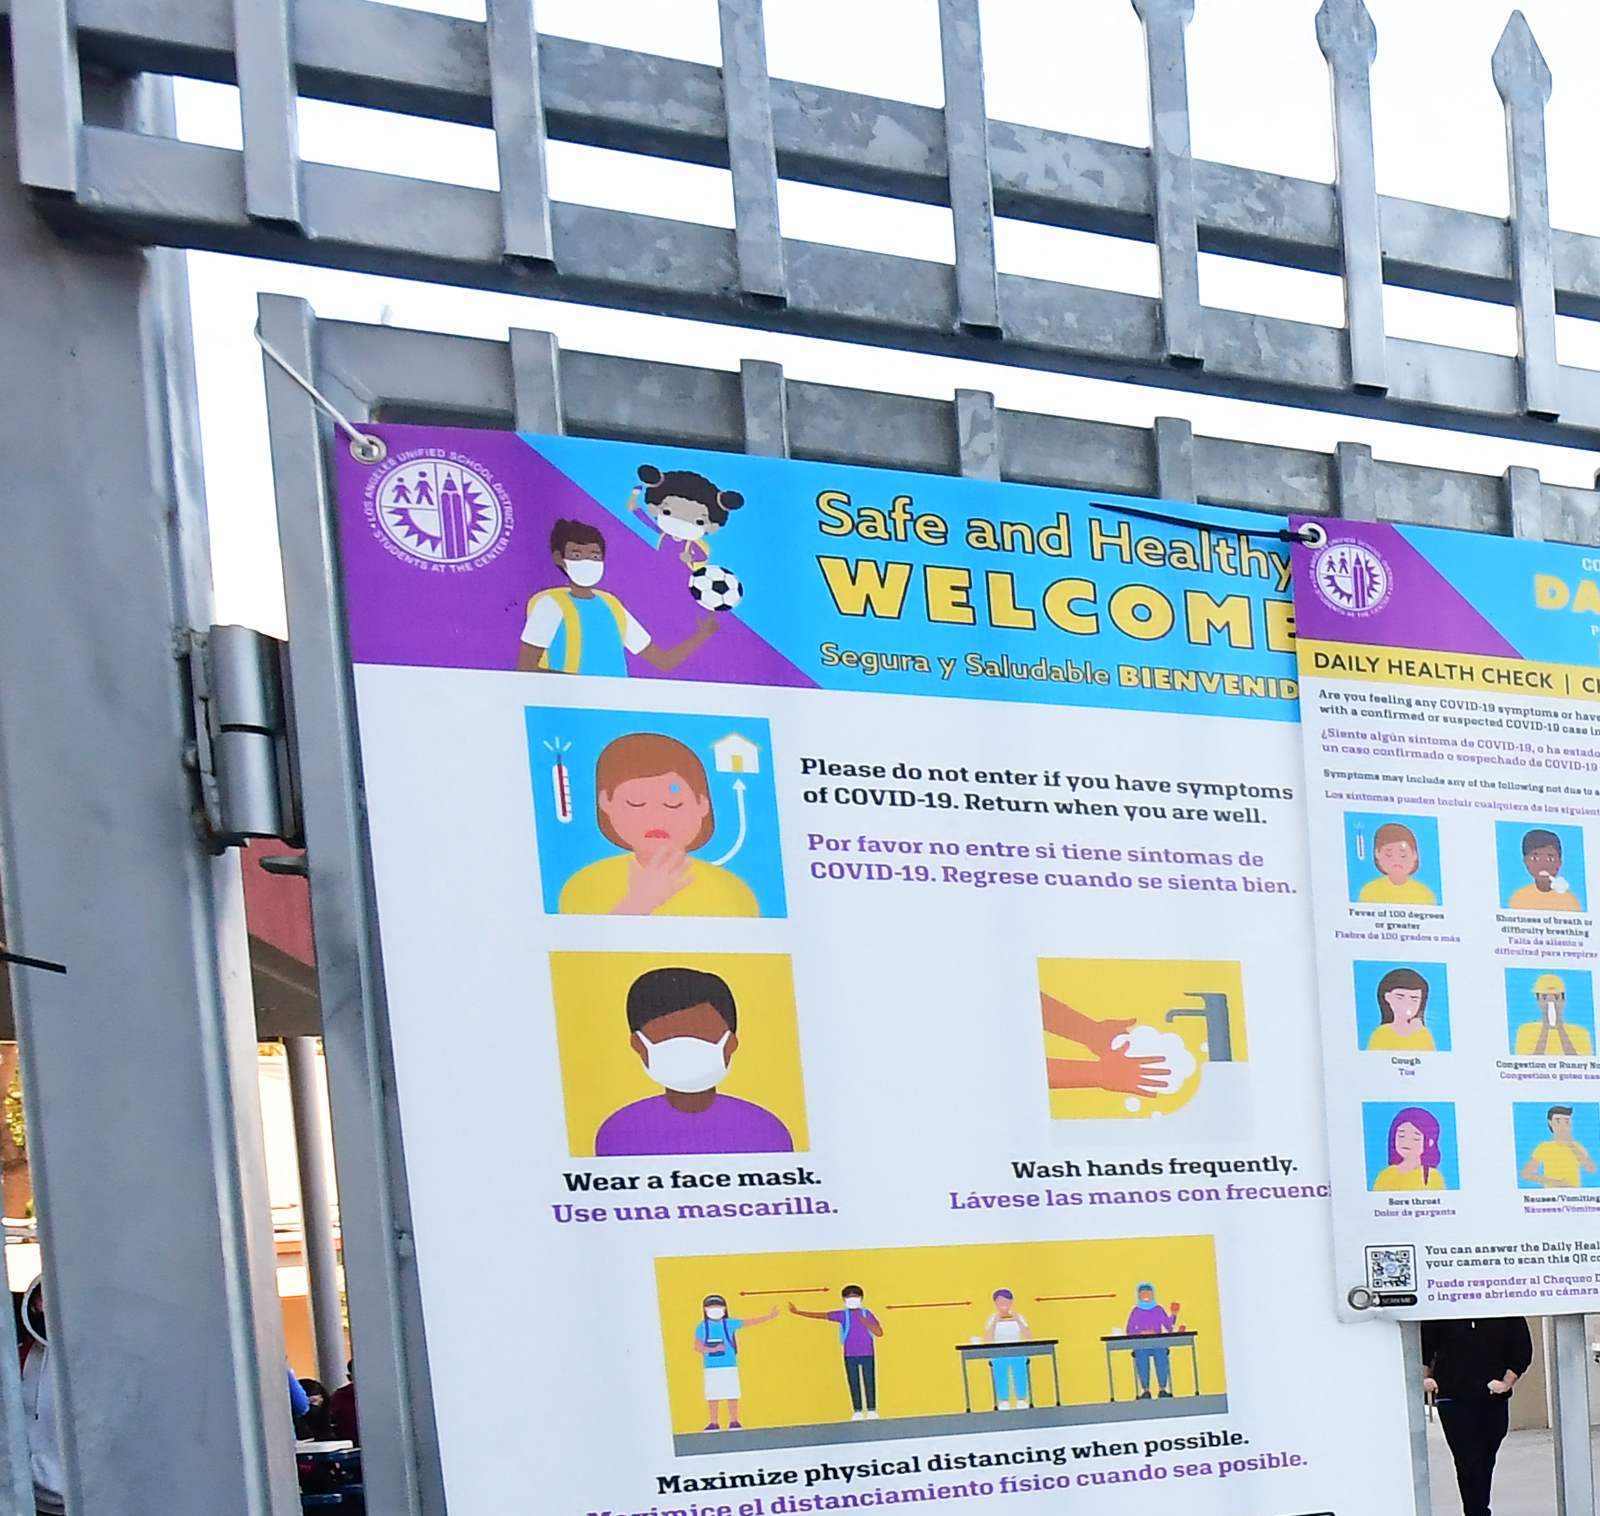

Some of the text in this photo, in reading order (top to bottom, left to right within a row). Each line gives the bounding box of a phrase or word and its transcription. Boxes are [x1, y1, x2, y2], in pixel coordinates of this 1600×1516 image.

[397, 448, 446, 462] UNIFIED
[450, 452, 494, 481] SCHOOL
[373, 530, 428, 571] STUDENTS
[431, 563, 445, 573] AT
[451, 563, 473, 573] THE
[817, 490, 949, 545] Safe
[966, 512, 1072, 559] and
[1089, 518, 1292, 592] Healthy
[817, 556, 1297, 654] WELCOME
[820, 643, 931, 676] Segura
[938, 656, 957, 681] y
[965, 653, 1110, 686] Saludable
[1314, 651, 1553, 689] DAILY HEALTH CHECK
[1318, 688, 1340, 699] Are
[1343, 693, 1366, 702] you
[1368, 692, 1412, 708] feeling
[1414, 699, 1437, 709] any
[1439, 698, 1495, 712] COVID-19
[1497, 706, 1558, 718] symptoms
[1560, 711, 1572, 719] or
[799, 757, 1292, 800] Please do not enter if you have symptoms
[803, 786, 1266, 823] of COVID-19. Return when you are well.
[807, 833, 1263, 866] Por favor no entre si tiene síntomas de
[810, 861, 1296, 893] COVID-19. Regrese cuando se sienta bien.
[562, 1166, 821, 1191] Wear a face mask.
[1010, 1155, 1297, 1178] Wash hands frequently.
[551, 1196, 838, 1223] Use una mascarilla.
[949, 1191, 1040, 1209] Lávese
[1044, 1189, 1082, 1206] las
[1088, 1189, 1171, 1204] manos
[1177, 1188, 1221, 1201] con
[1425, 1259, 1453, 1269] your
[1456, 1258, 1501, 1266] camera
[1503, 1256, 1515, 1264] to
[1517, 1256, 1545, 1264] scan
[1547, 1254, 1569, 1263] this
[1572, 1253, 1587, 1264] QR
[655, 1430, 1249, 1494] Maximize physical distancing when possible.
[738, 1498, 764, 1516] el
[770, 1480, 993, 1514] distanciamiento
[999, 1473, 1069, 1493] físico
[1076, 1463, 1167, 1486] cuando
[1173, 1462, 1212, 1477] sea
[1218, 1451, 1307, 1477] posible.
